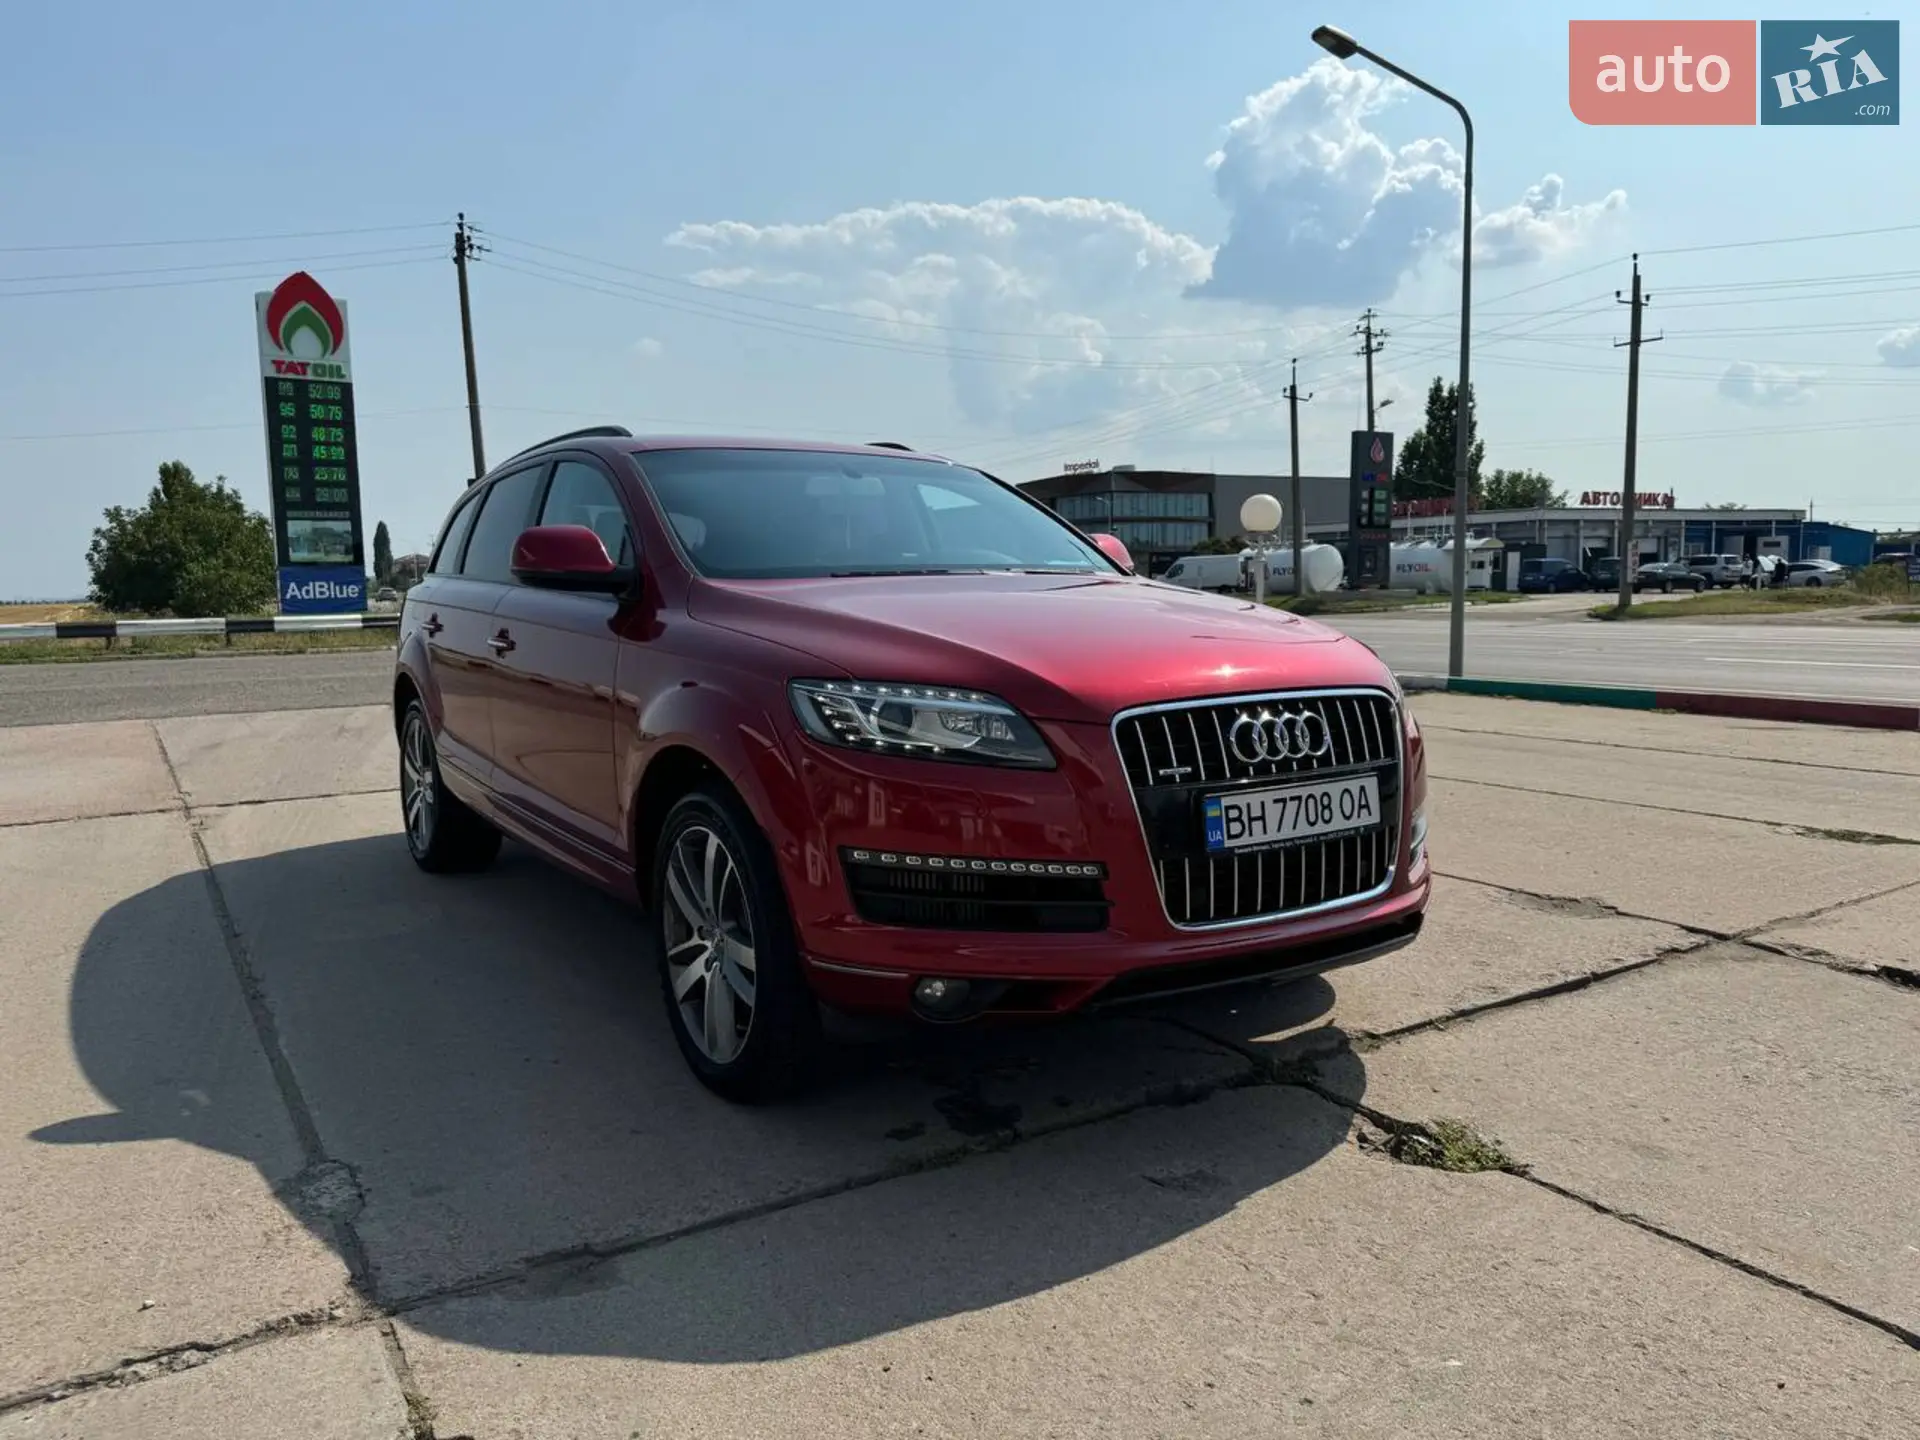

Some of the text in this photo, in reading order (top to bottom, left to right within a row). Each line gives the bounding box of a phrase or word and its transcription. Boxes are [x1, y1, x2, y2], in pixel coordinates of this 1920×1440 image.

[1224, 784, 1373, 841] BH 7708 OA
[1208, 830, 1223, 842] UA
